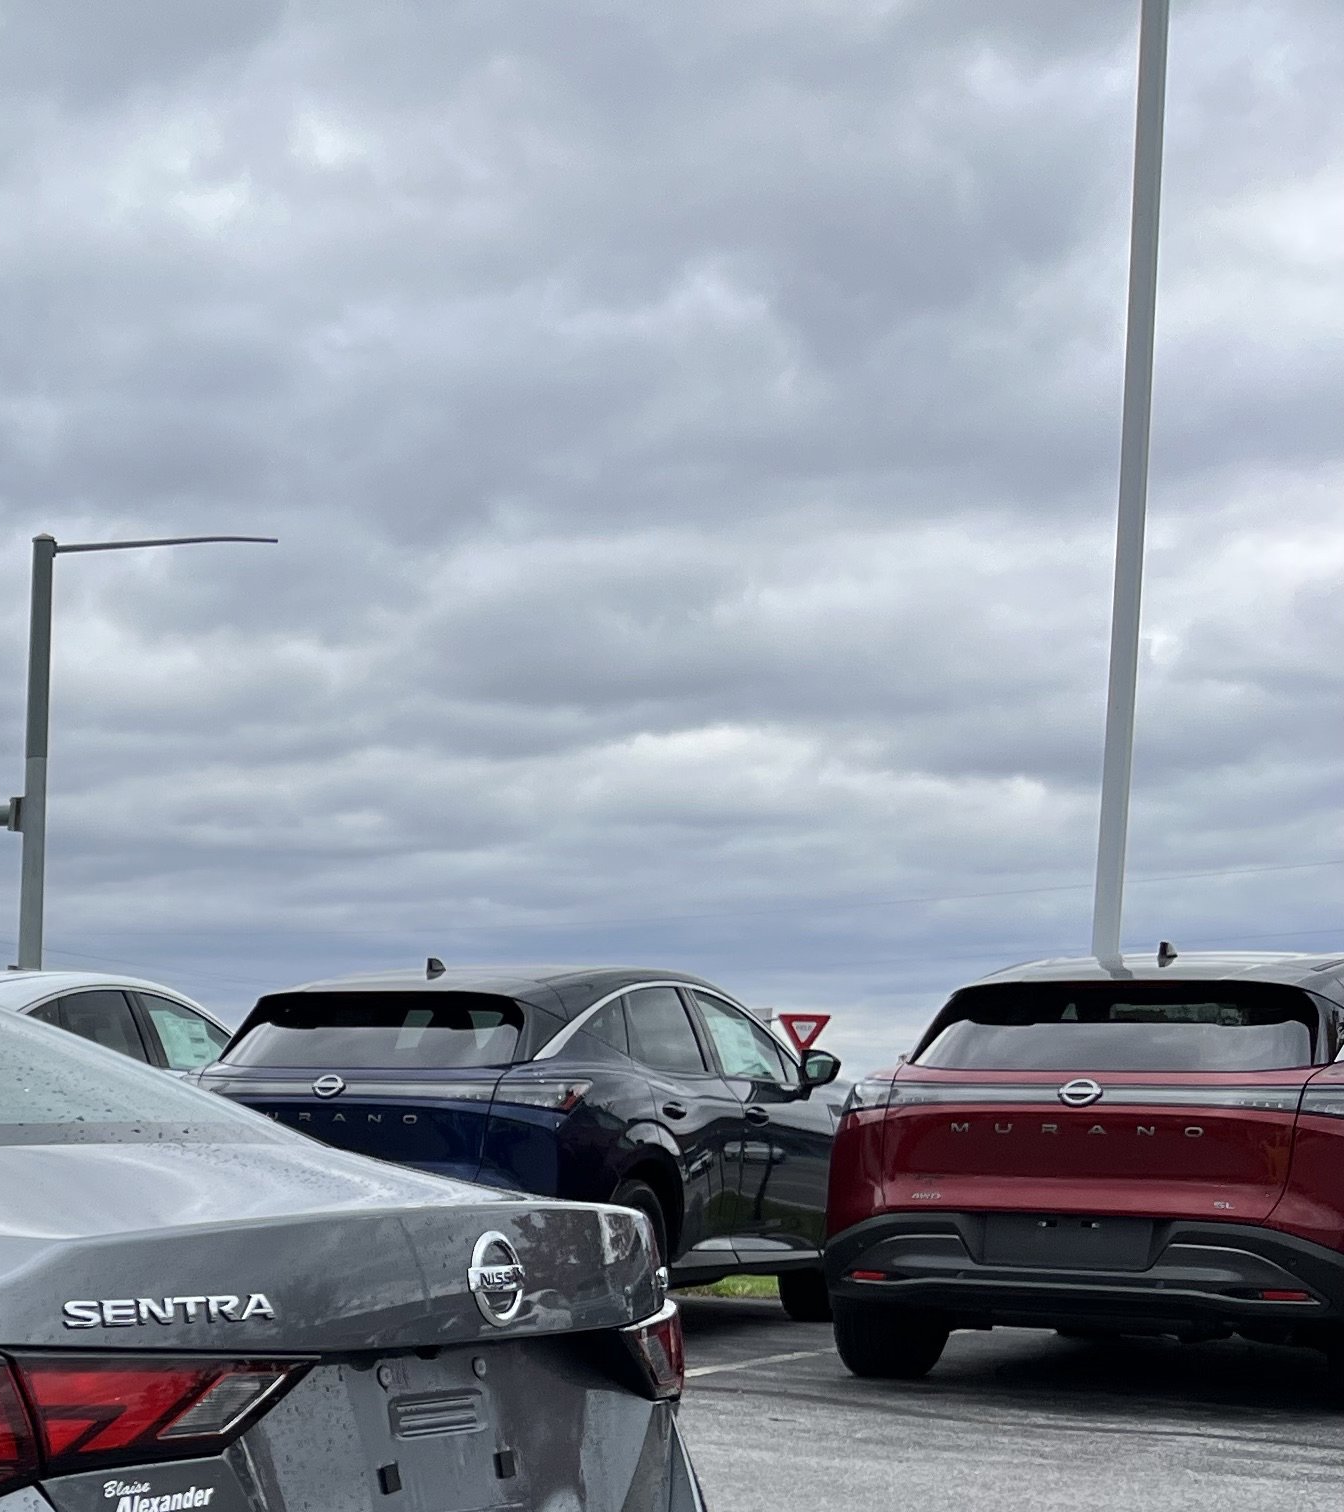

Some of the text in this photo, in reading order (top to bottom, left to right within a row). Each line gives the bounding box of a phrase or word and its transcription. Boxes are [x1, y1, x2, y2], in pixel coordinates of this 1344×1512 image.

[265, 1111, 418, 1125] URANO
[950, 1122, 1205, 1138] MURANO
[911, 1192, 942, 1200] AWD
[63, 1293, 277, 1330] SENTRA
[103, 1480, 152, 1498] Blaise
